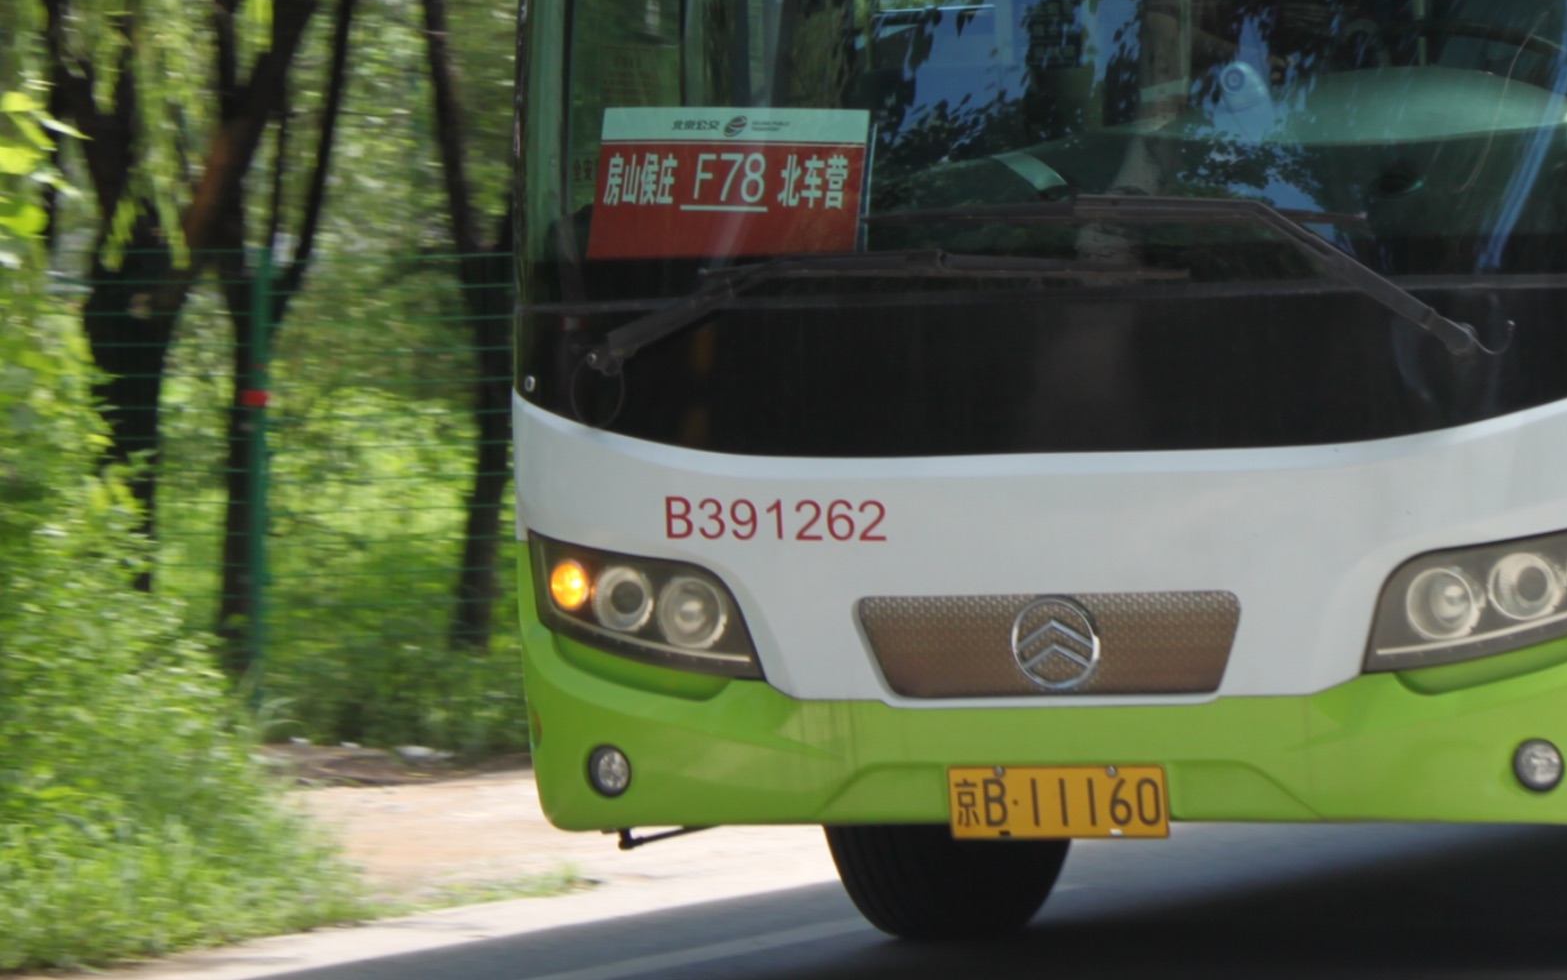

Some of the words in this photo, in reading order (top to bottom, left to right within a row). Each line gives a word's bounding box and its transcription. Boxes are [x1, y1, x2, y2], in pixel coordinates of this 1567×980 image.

[693, 152, 766, 202] F78
[777, 154, 849, 209] 北车营
[665, 496, 887, 541] B391262
[954, 777, 1162, 828] 京B·11160
